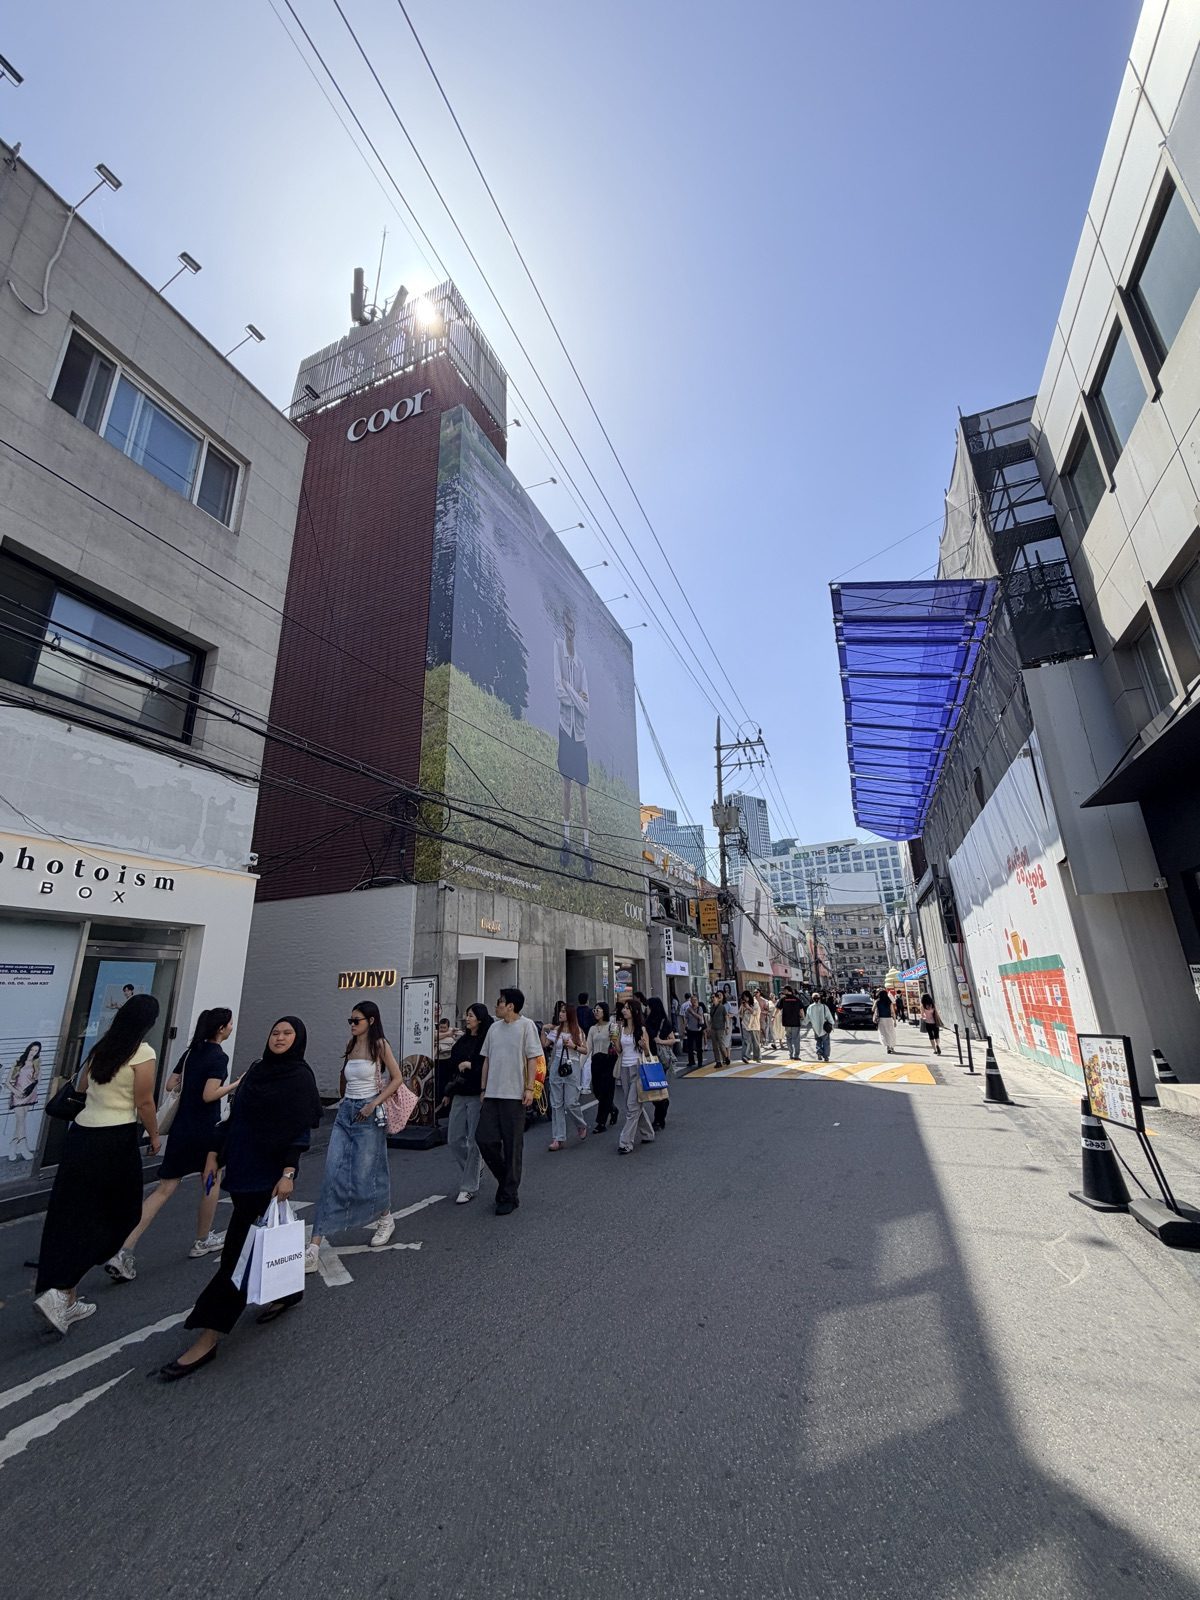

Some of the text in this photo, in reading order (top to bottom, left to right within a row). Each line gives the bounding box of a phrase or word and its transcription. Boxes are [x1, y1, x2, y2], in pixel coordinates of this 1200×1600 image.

[346, 388, 432, 442] coor
[827, 846, 851, 855] SPACE
[40, 881, 126, 904] BOX
[265, 1251, 303, 1269] TAMBURINS
